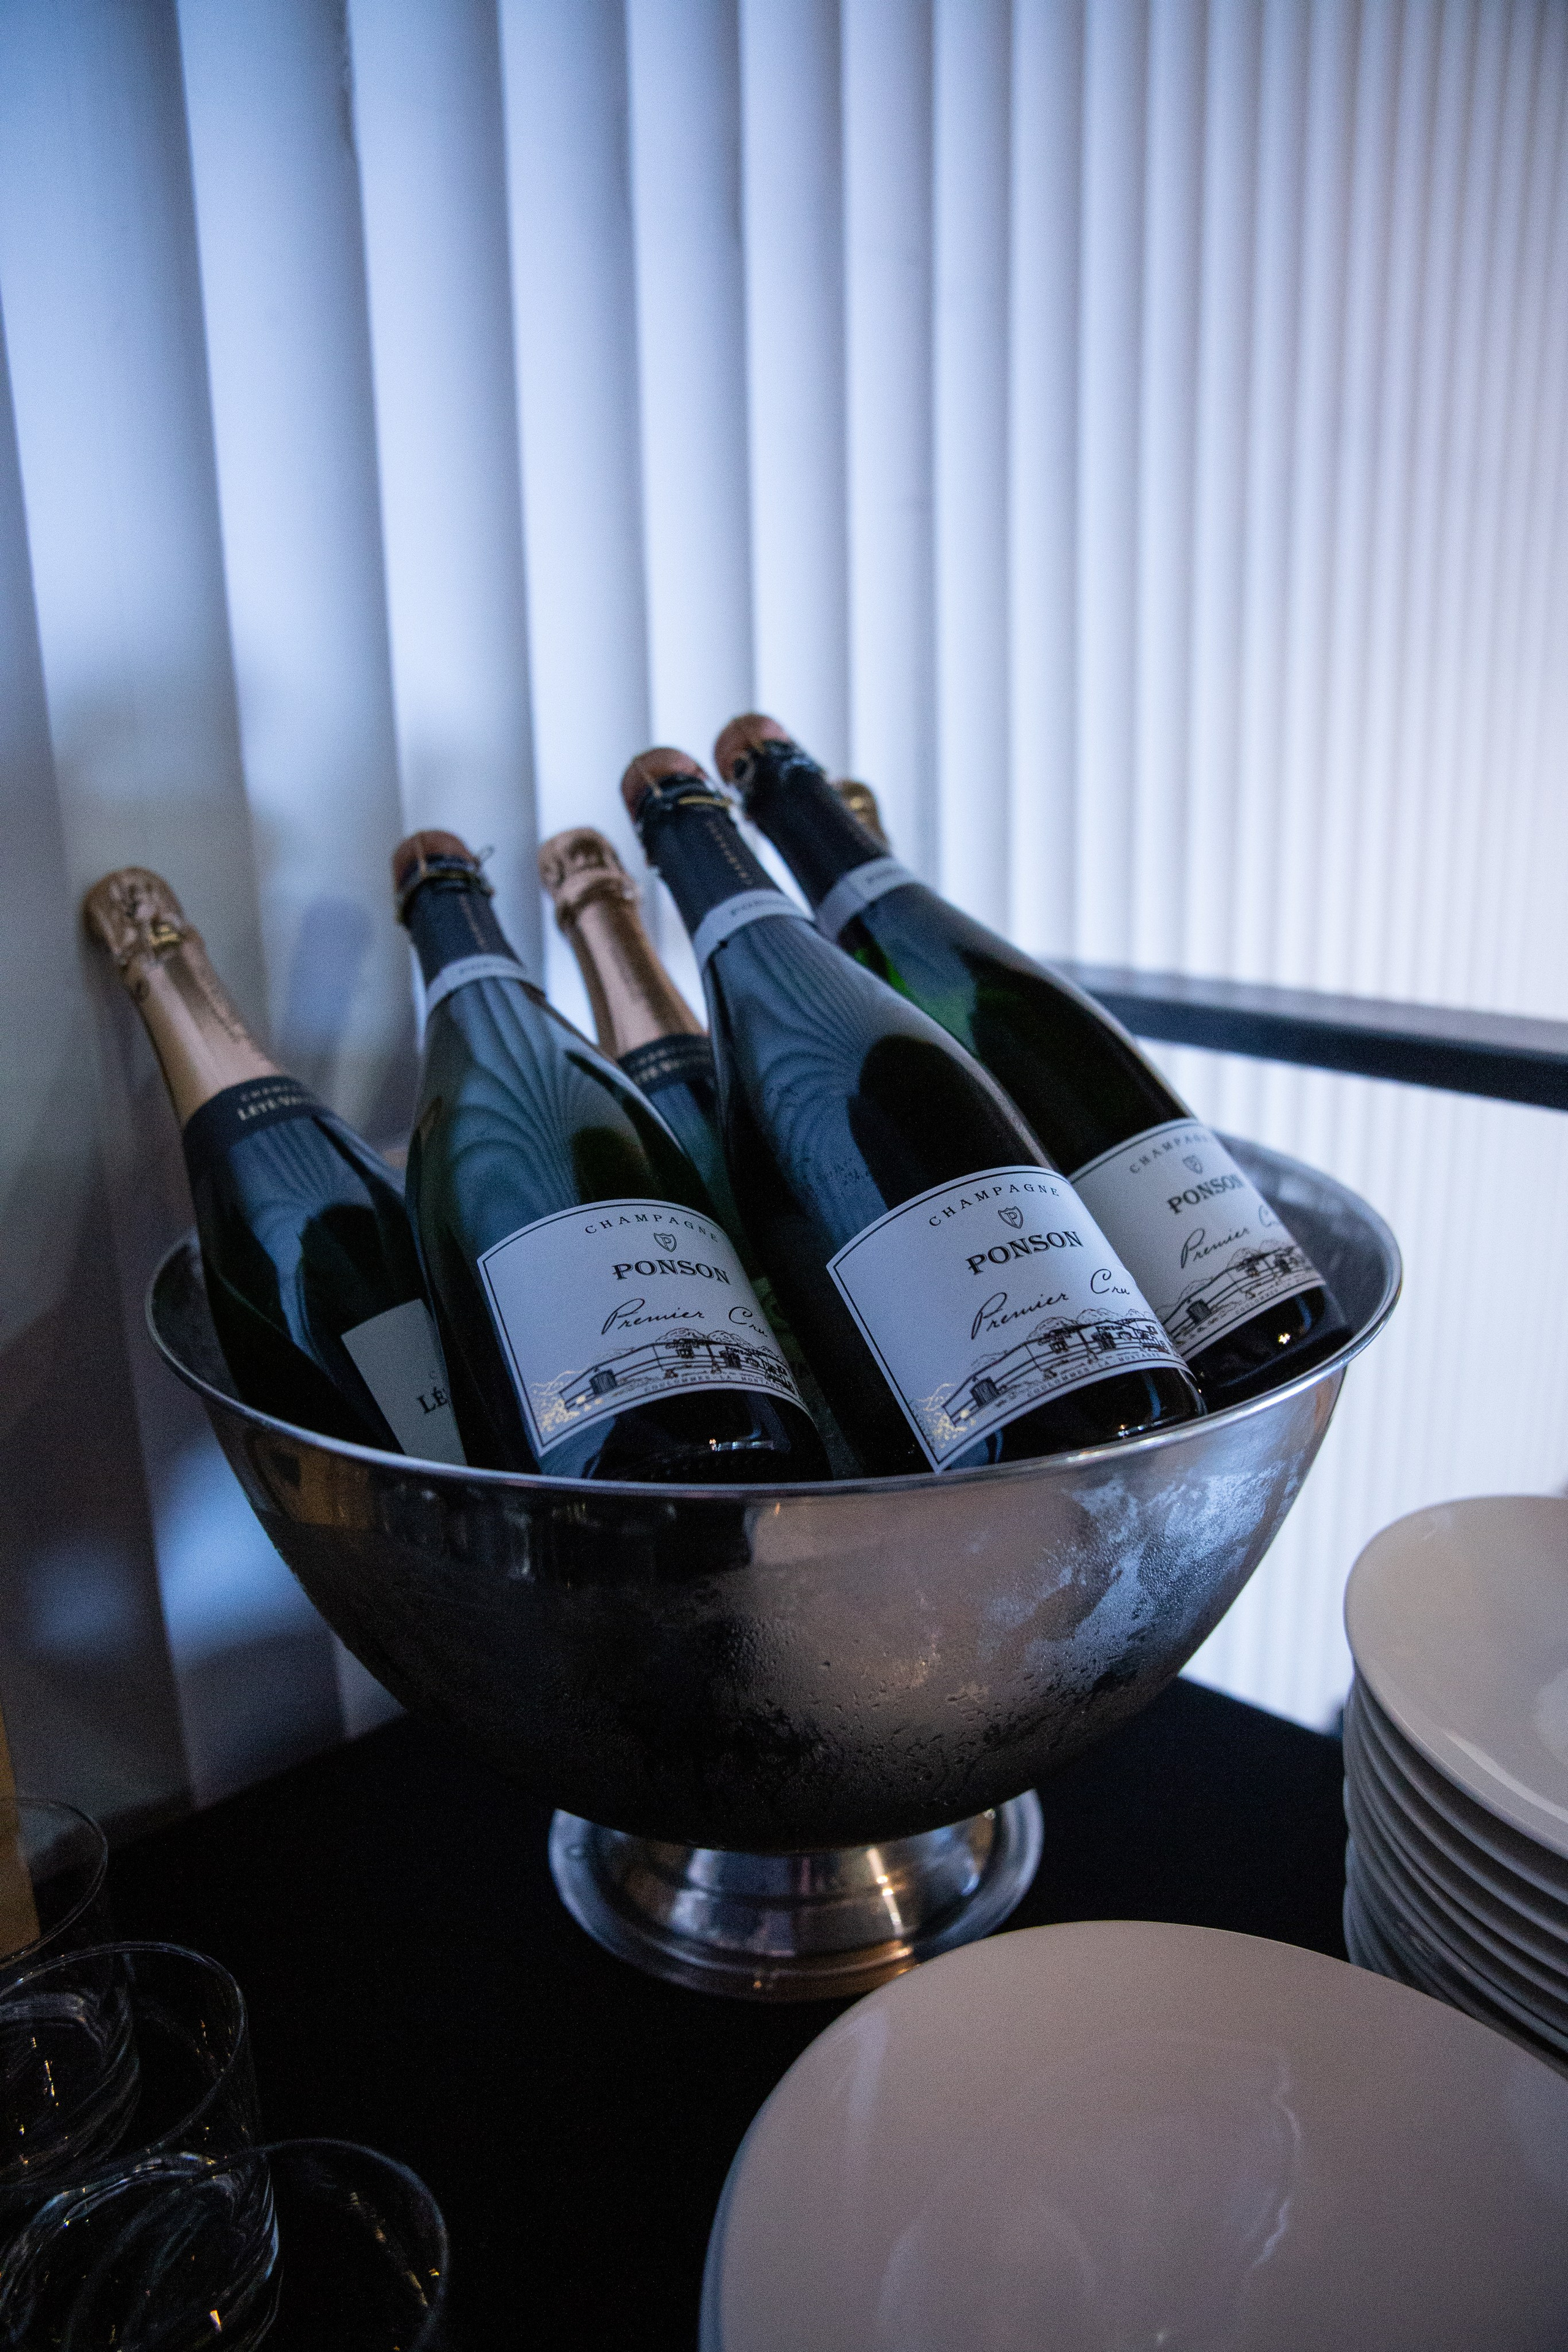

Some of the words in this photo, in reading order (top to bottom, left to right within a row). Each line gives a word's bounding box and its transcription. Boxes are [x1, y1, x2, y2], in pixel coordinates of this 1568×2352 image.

[929, 1183, 1060, 1227] CHAMPAGNE
[585, 1213, 718, 1243] CHAMPAGNE
[1180, 1227, 1250, 1269] Premier
[611, 1259, 731, 1286] PONSON
[965, 1231, 1084, 1275] PONSON
[601, 1297, 705, 1335] Premier
[728, 1306, 768, 1337] Cru
[971, 1292, 1069, 1340] Premier
[1090, 1268, 1130, 1295] Cru
